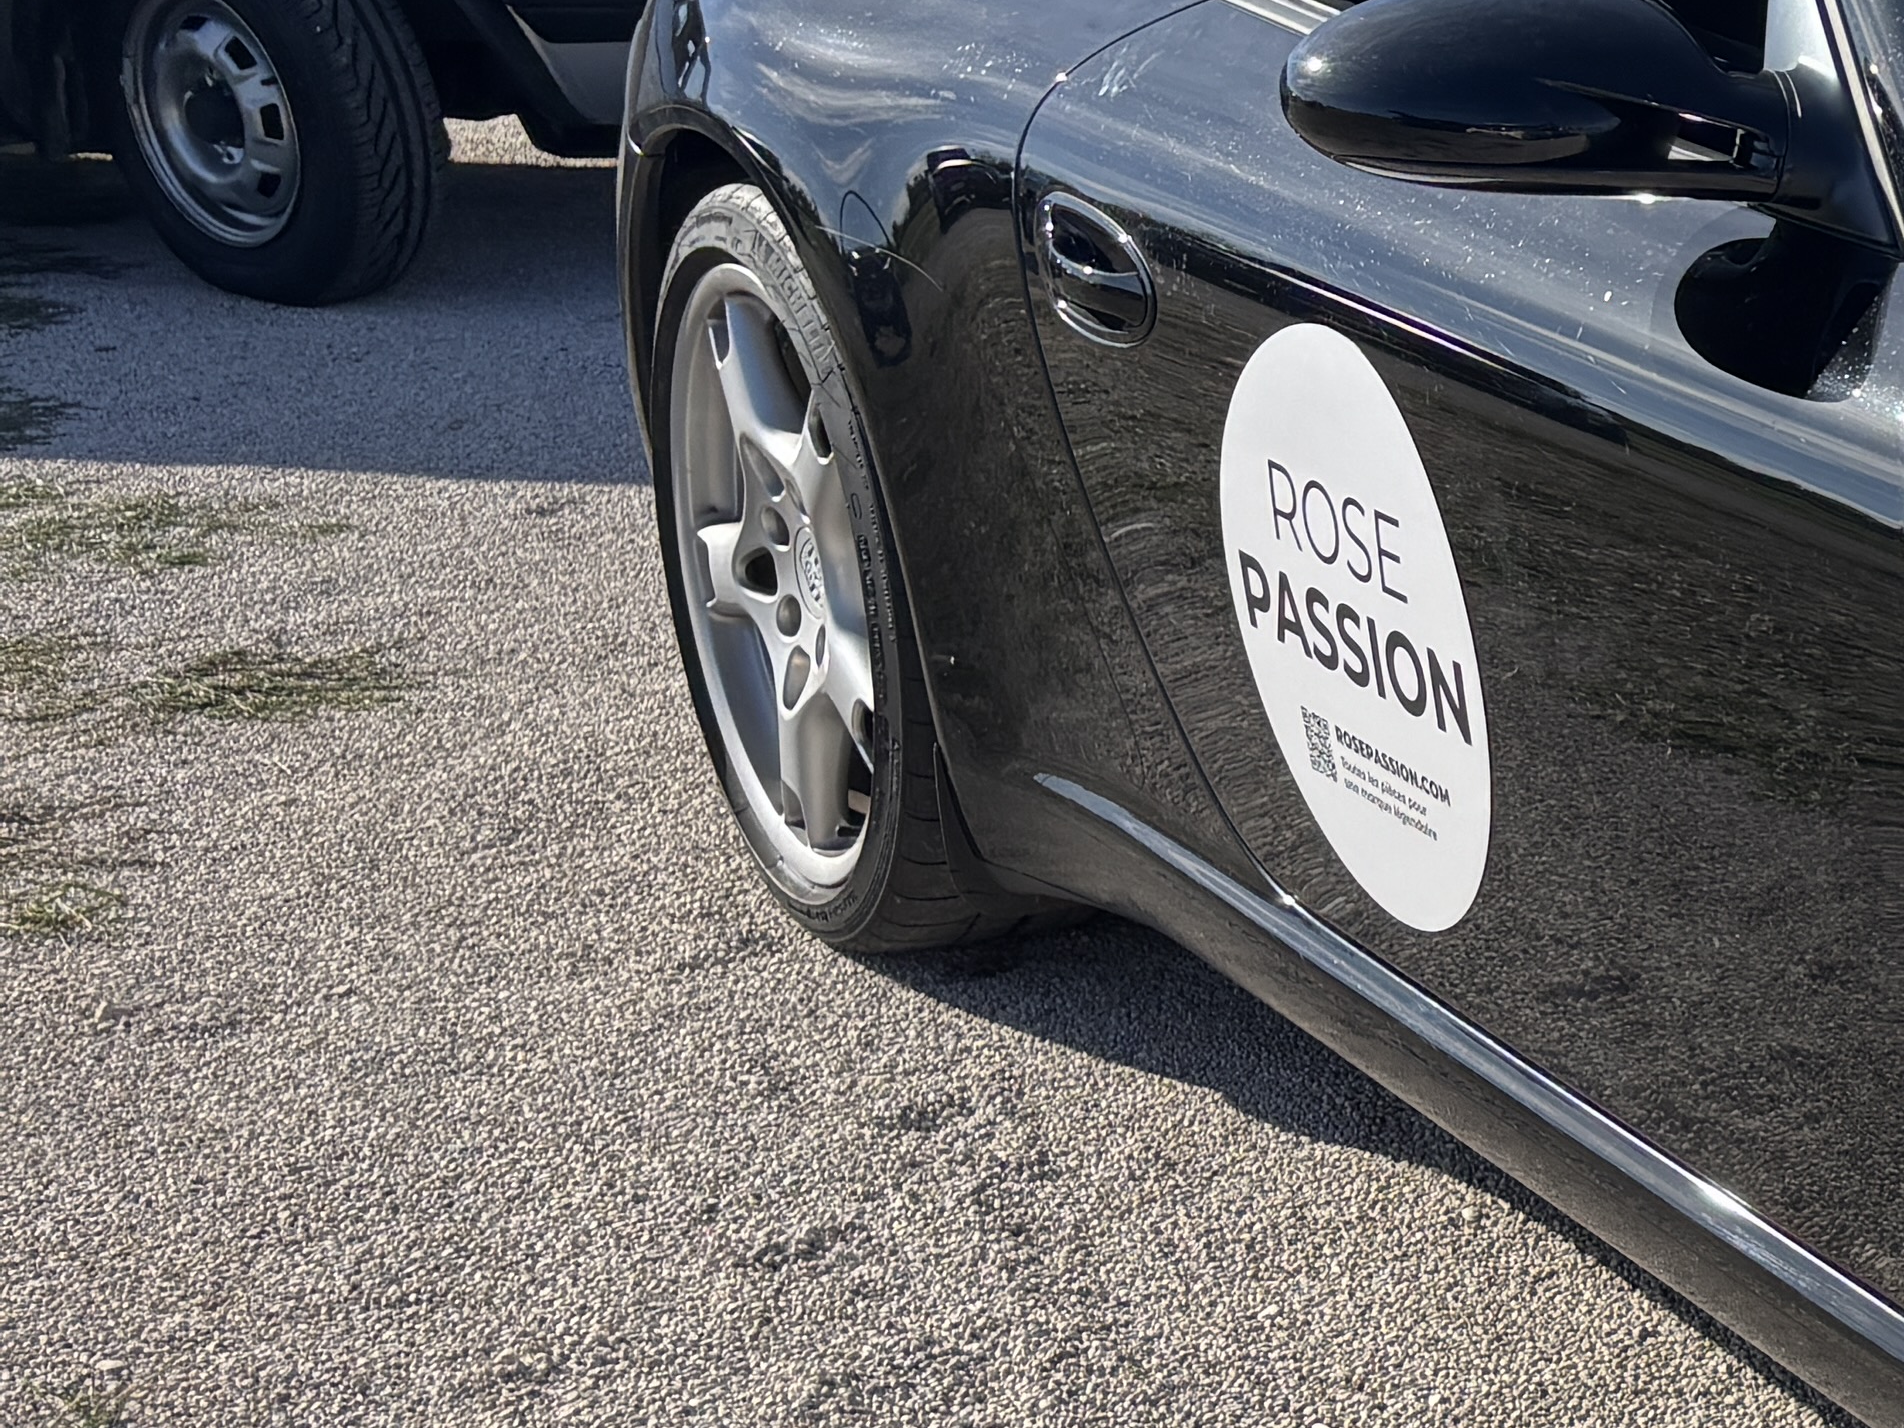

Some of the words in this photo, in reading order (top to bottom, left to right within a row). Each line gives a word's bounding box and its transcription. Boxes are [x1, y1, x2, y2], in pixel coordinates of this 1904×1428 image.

[1266, 458, 1408, 605] ROSE
[1238, 548, 1473, 747] PASSION
[1334, 724, 1452, 808] ROSEPASSION.COM
